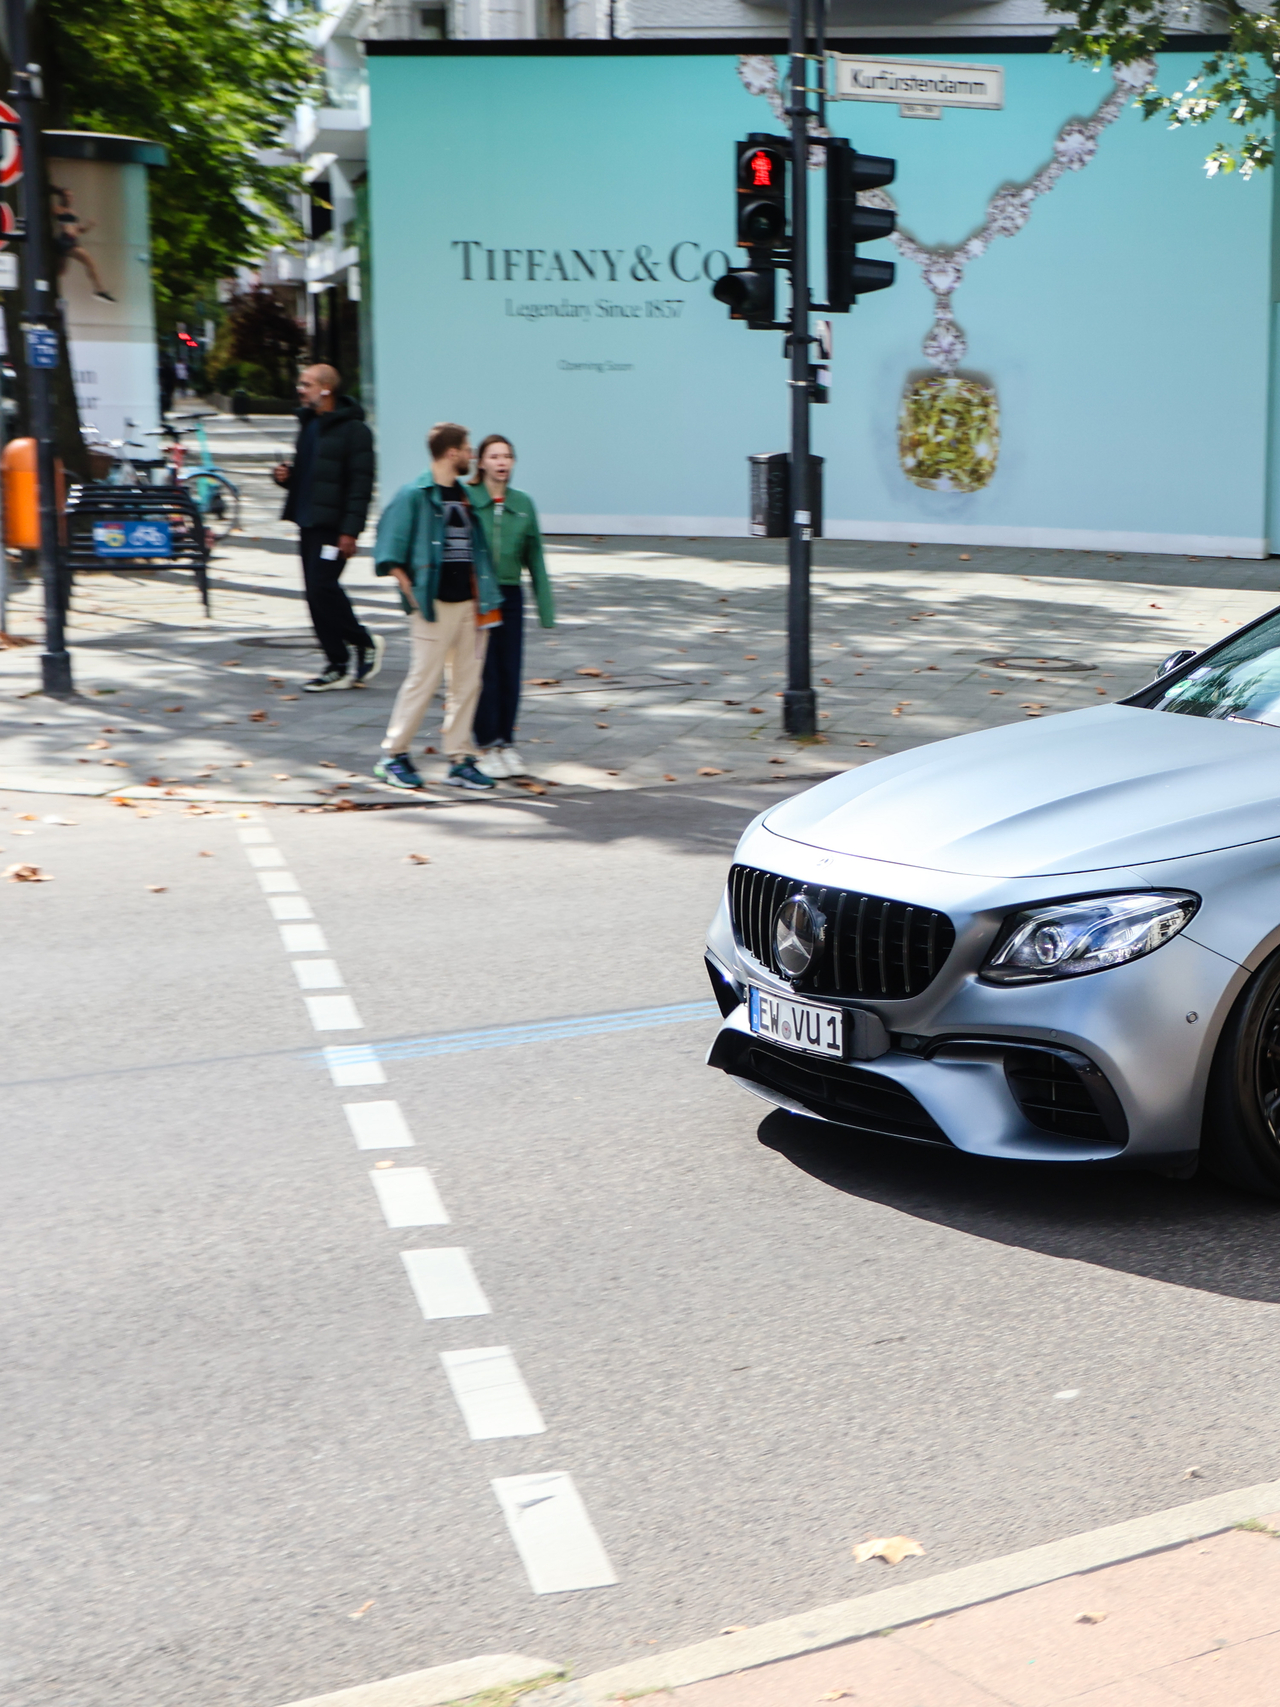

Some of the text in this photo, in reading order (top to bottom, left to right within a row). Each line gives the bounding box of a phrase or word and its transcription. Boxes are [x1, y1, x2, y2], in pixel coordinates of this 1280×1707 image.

[850, 68, 988, 96] Kurfürstendamm
[452, 240, 624, 282] TIFFANY
[629, 244, 660, 281] &
[505, 299, 590, 321] Legendary
[595, 300, 642, 318] Since
[557, 359, 635, 373] Opening Soon
[759, 995, 841, 1051] EW VU 1
